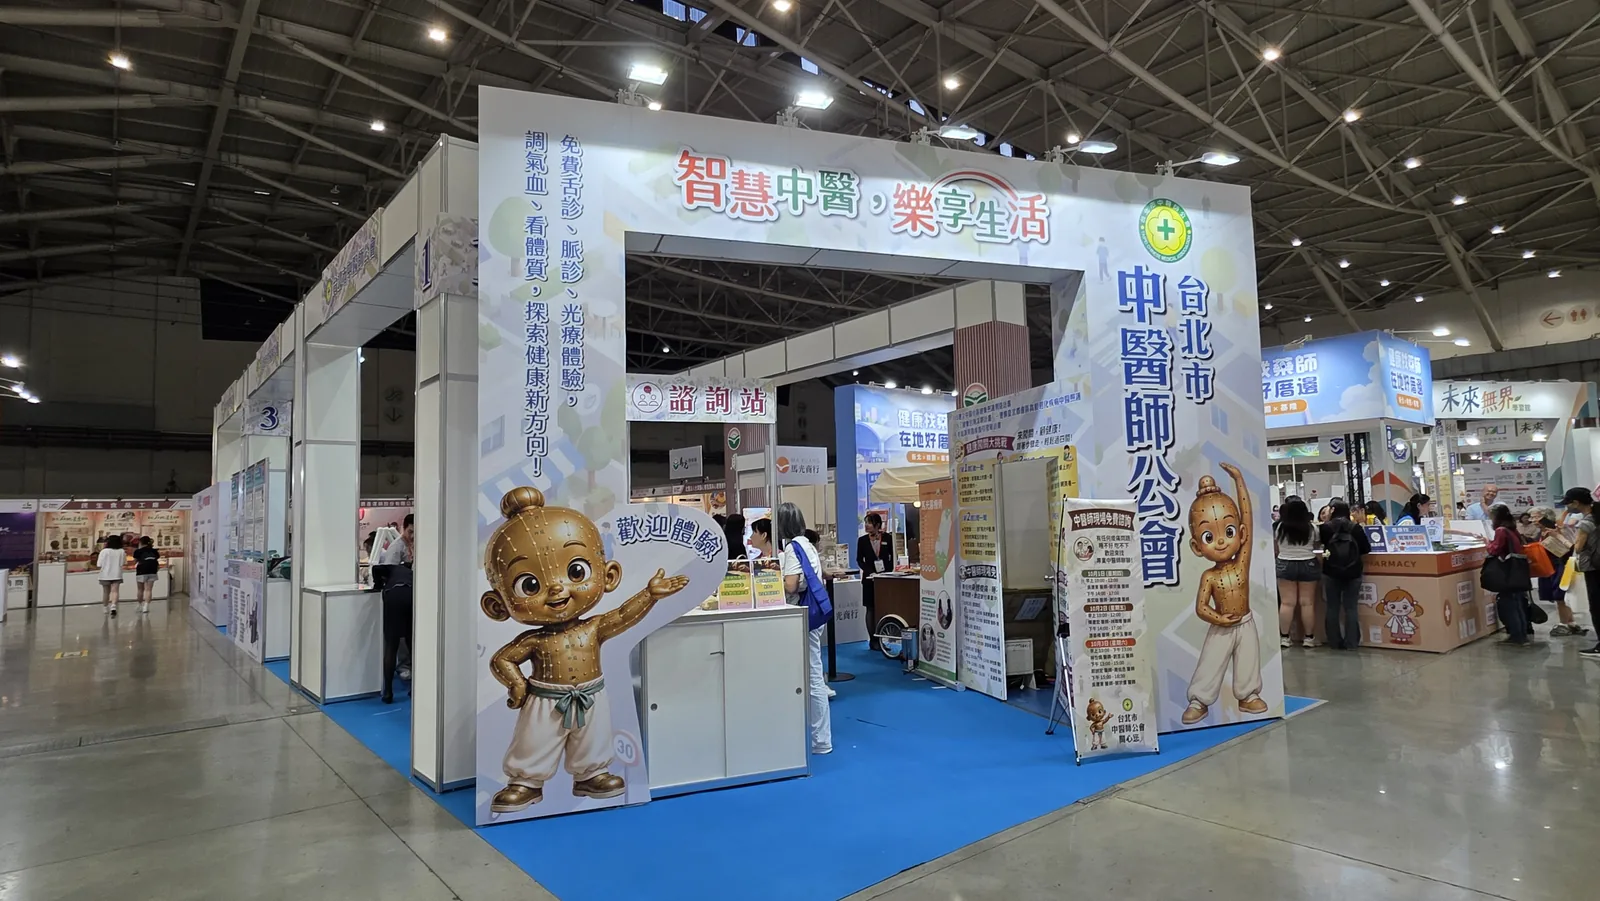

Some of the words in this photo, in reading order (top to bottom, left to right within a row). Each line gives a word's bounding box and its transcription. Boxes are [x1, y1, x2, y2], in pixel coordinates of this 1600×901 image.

[676, 149, 1048, 240] 智慧中醫，樂享生活
[1177, 274, 1215, 403] 台北市
[668, 385, 768, 416] 諮詢站
[1441, 384, 1514, 415] 未來無界
[260, 405, 279, 430] 3
[1116, 264, 1181, 587] 中醫師公會
[616, 514, 723, 562] 歡迎體驗
[836, 609, 858, 621] 光商行
[1117, 713, 1138, 723] 台北市
[616, 738, 634, 760] 30
